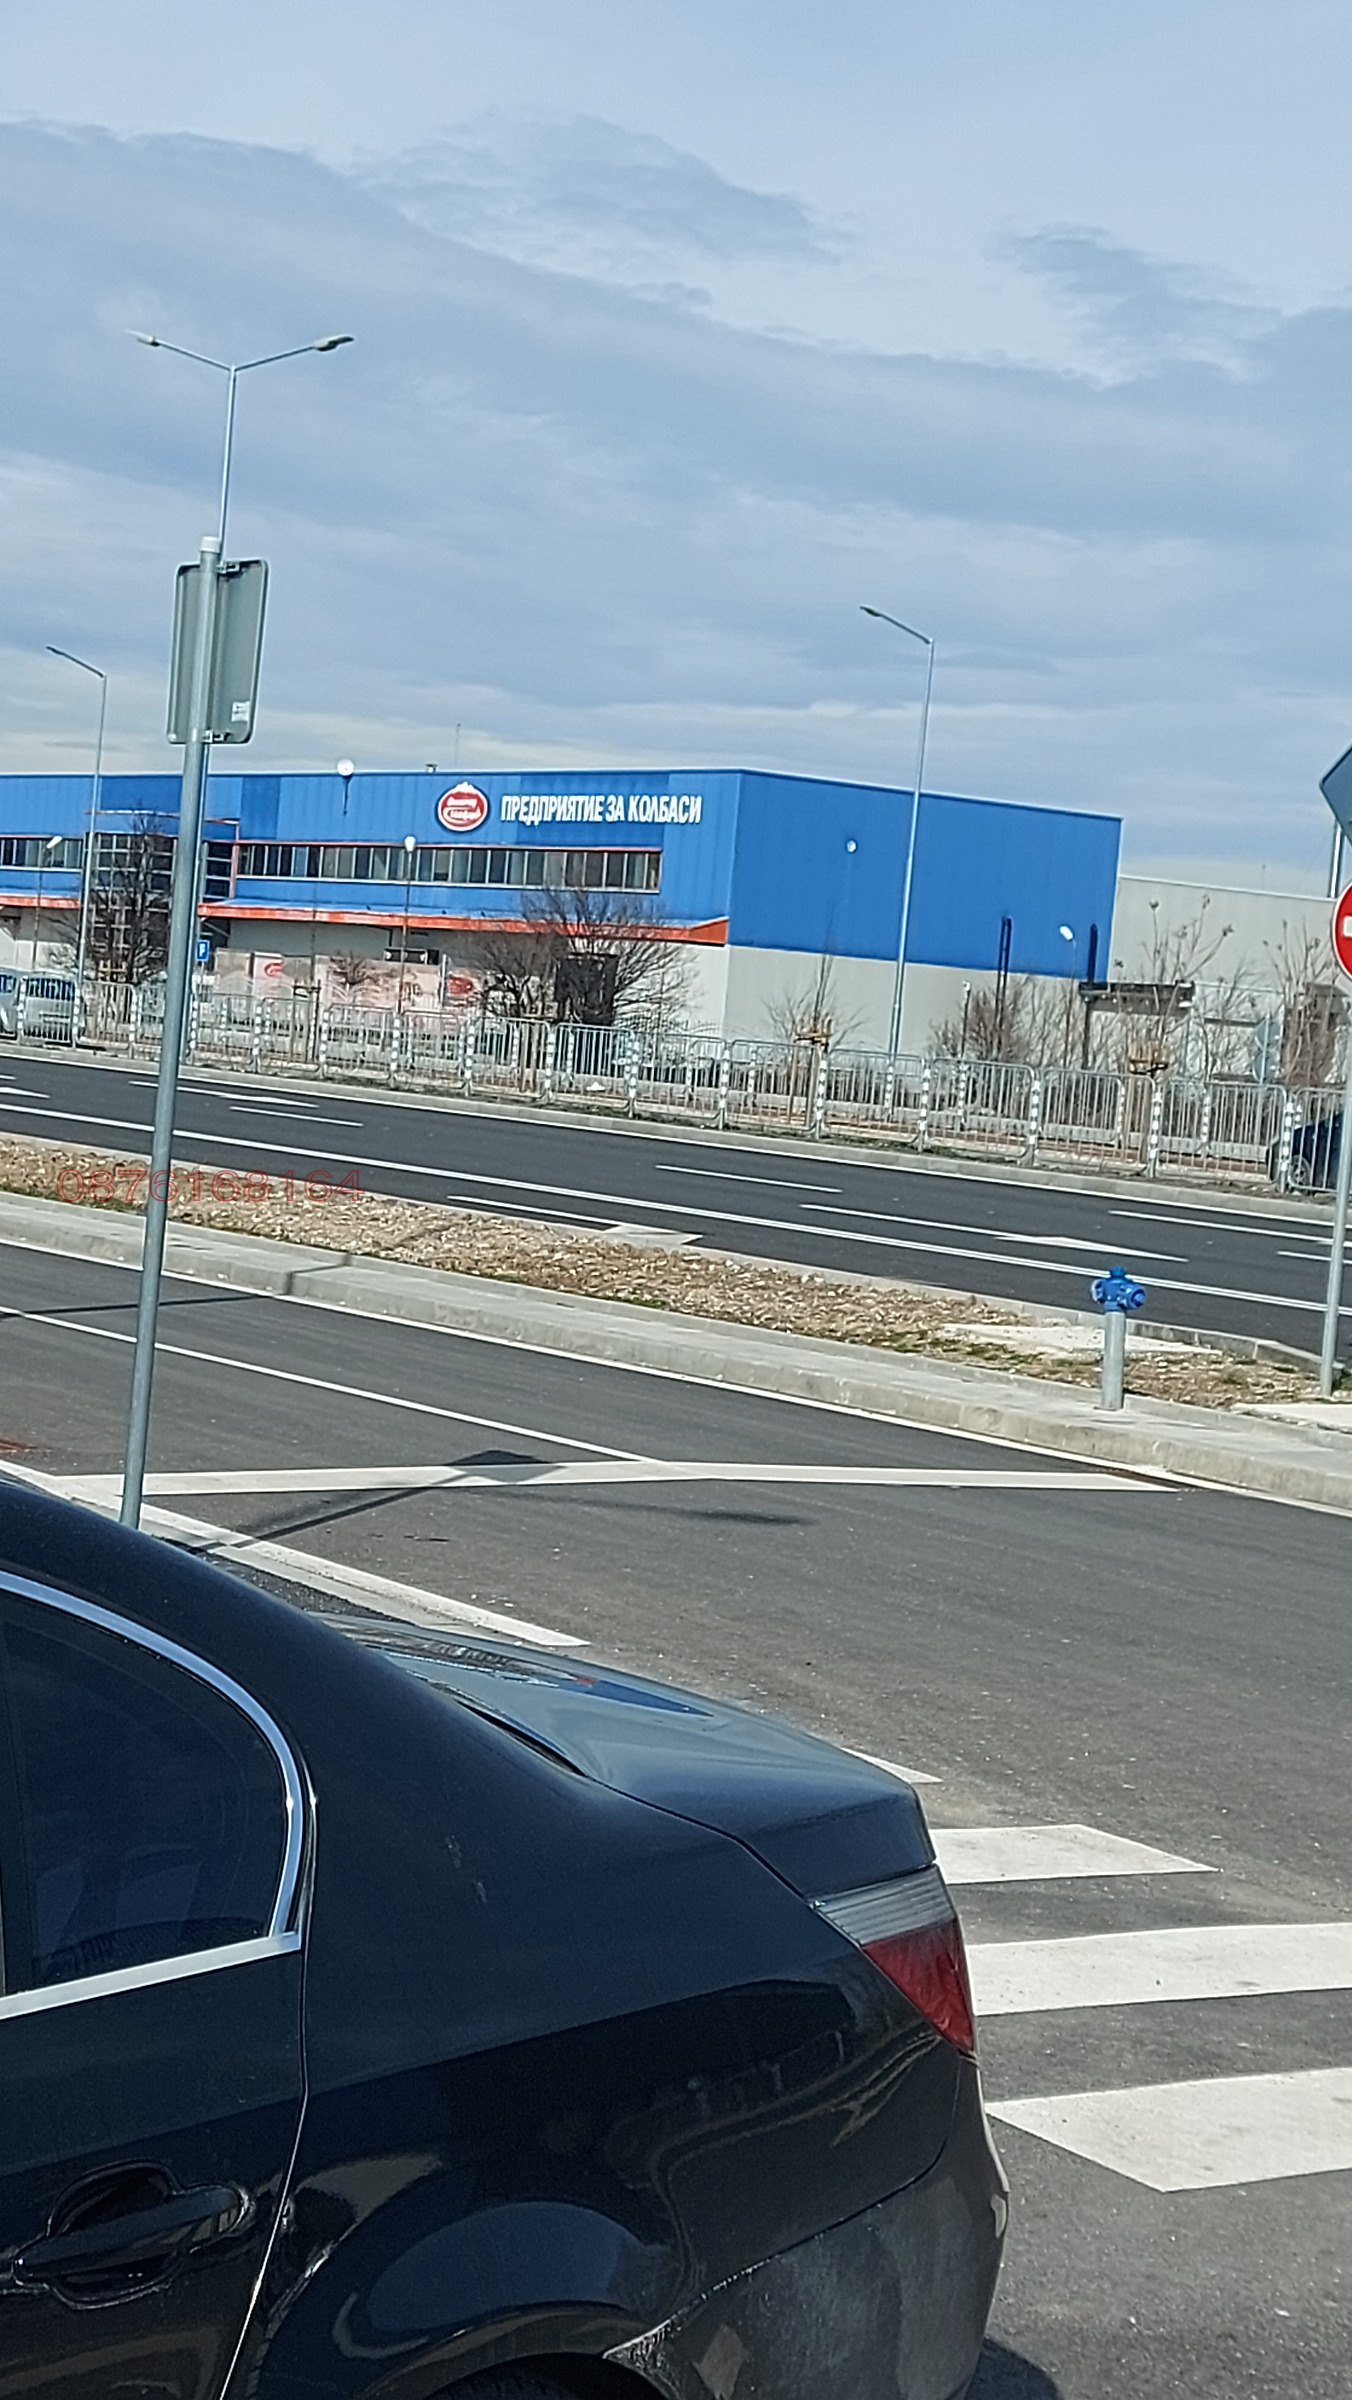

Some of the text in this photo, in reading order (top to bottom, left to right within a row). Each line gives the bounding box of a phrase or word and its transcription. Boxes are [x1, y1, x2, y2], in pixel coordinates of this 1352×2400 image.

[500, 794, 604, 826] ПРЕДПРИЯТИЕ
[605, 795, 625, 822] ЗА
[628, 795, 702, 824] КОЛБАСИ
